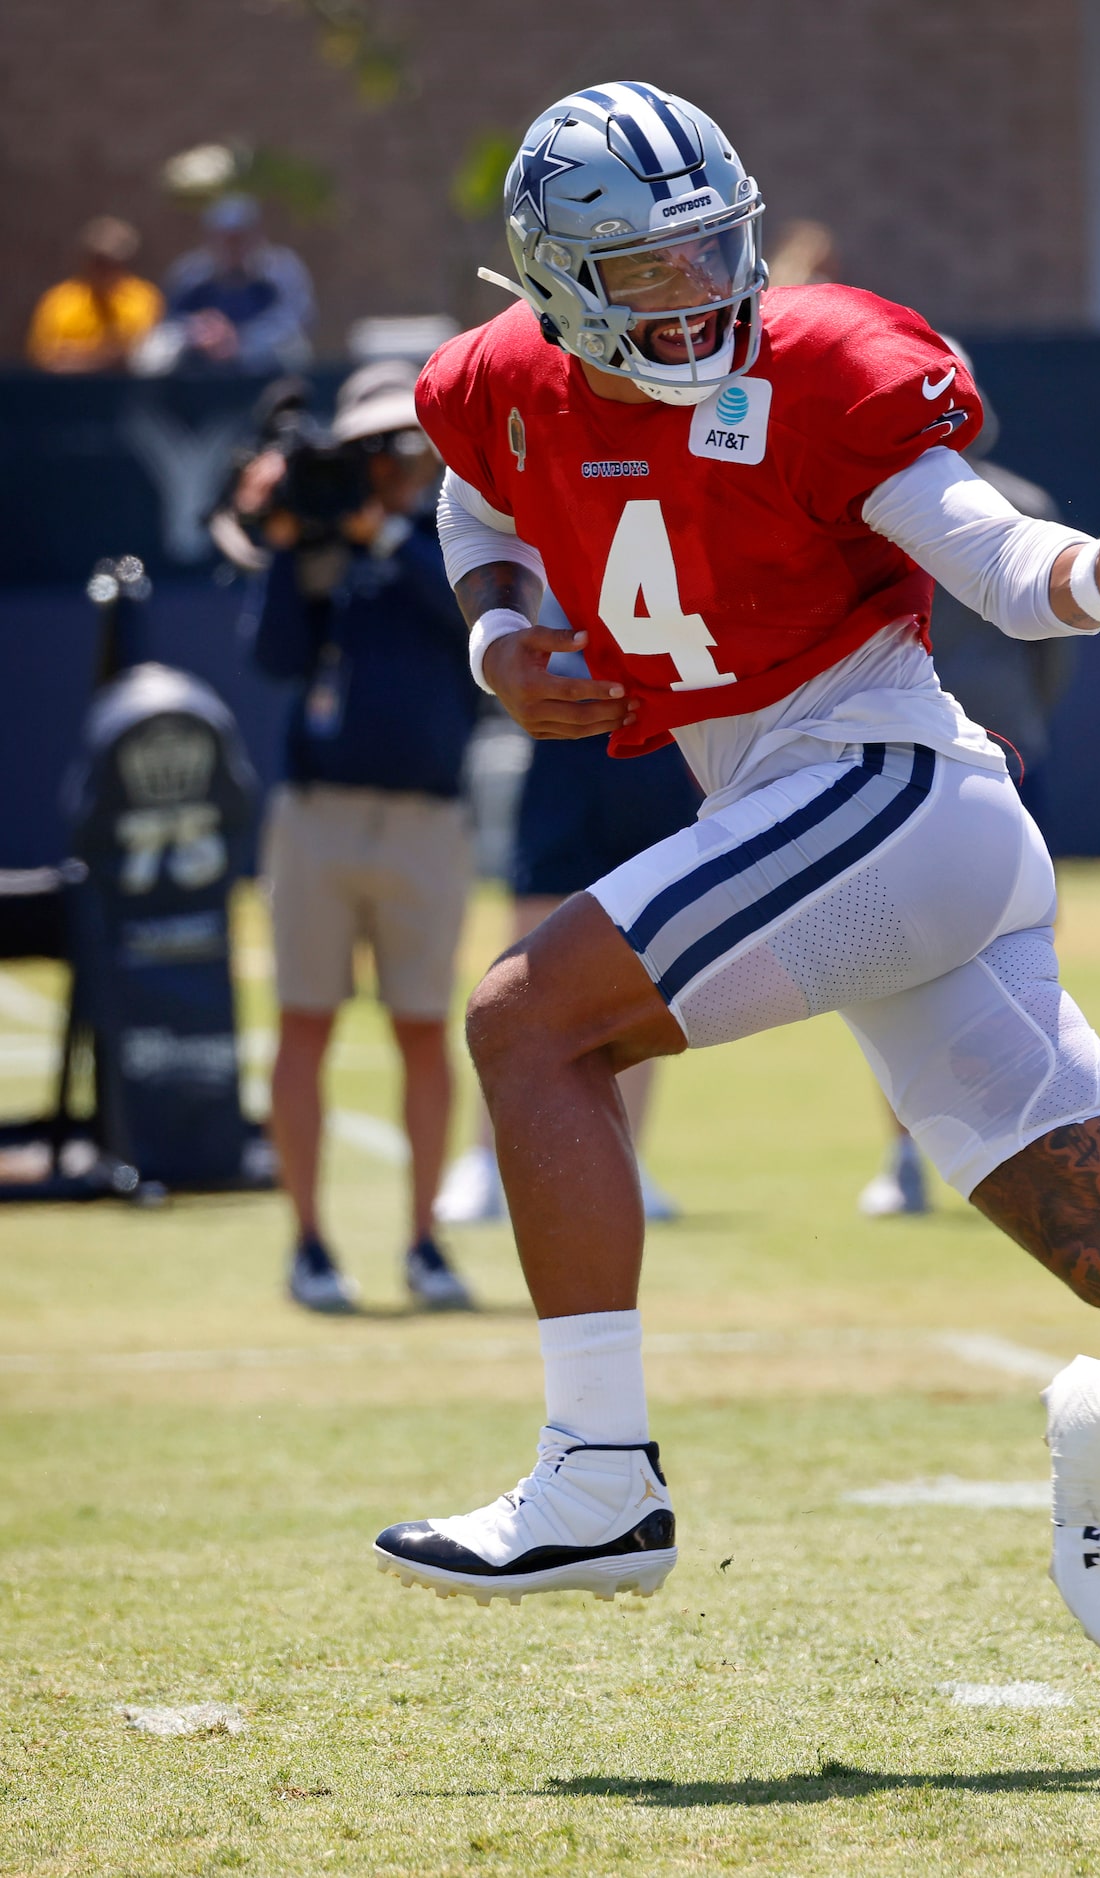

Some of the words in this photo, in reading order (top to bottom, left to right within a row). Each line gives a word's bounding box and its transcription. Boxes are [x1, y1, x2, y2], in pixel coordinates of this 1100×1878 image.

[662, 195, 712, 217] COWBOYS
[705, 429, 749, 451] AT&T
[582, 461, 649, 478] COWBOYS
[598, 499, 738, 692] 4
